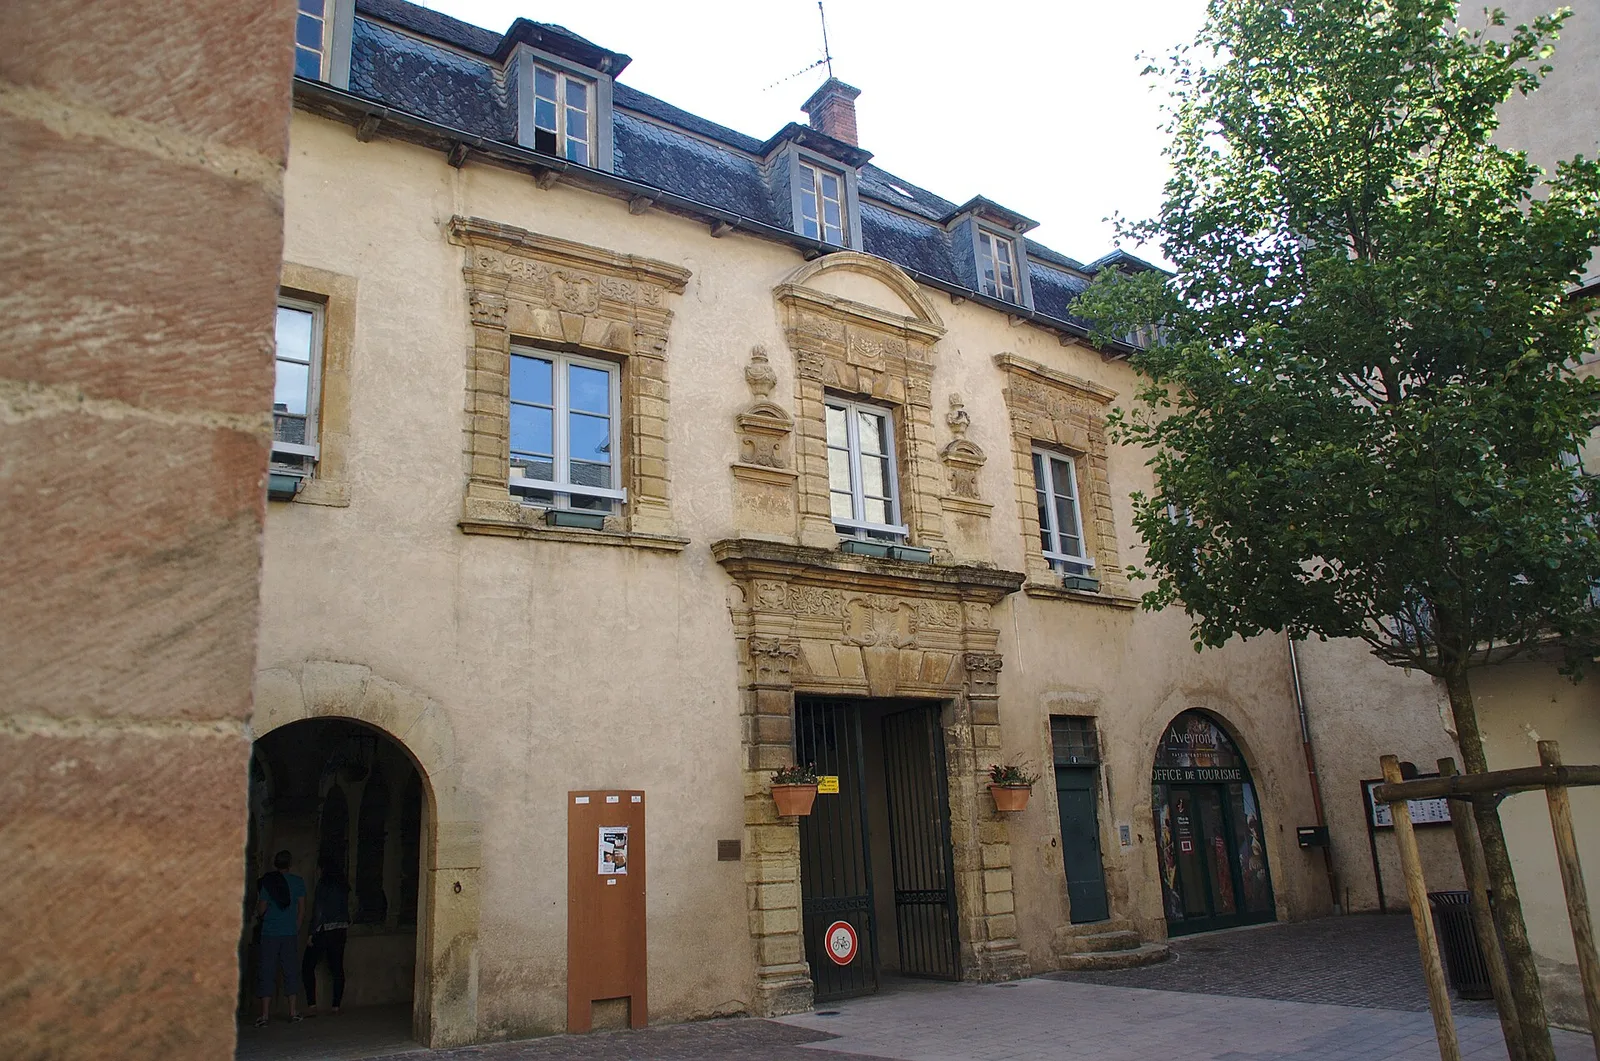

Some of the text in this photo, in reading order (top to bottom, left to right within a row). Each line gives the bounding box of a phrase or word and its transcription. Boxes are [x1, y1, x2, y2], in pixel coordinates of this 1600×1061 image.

[1170, 727, 1212, 748] Aveyron
[1185, 770, 1195, 780] DE
[1197, 768, 1241, 780] TOURISME
